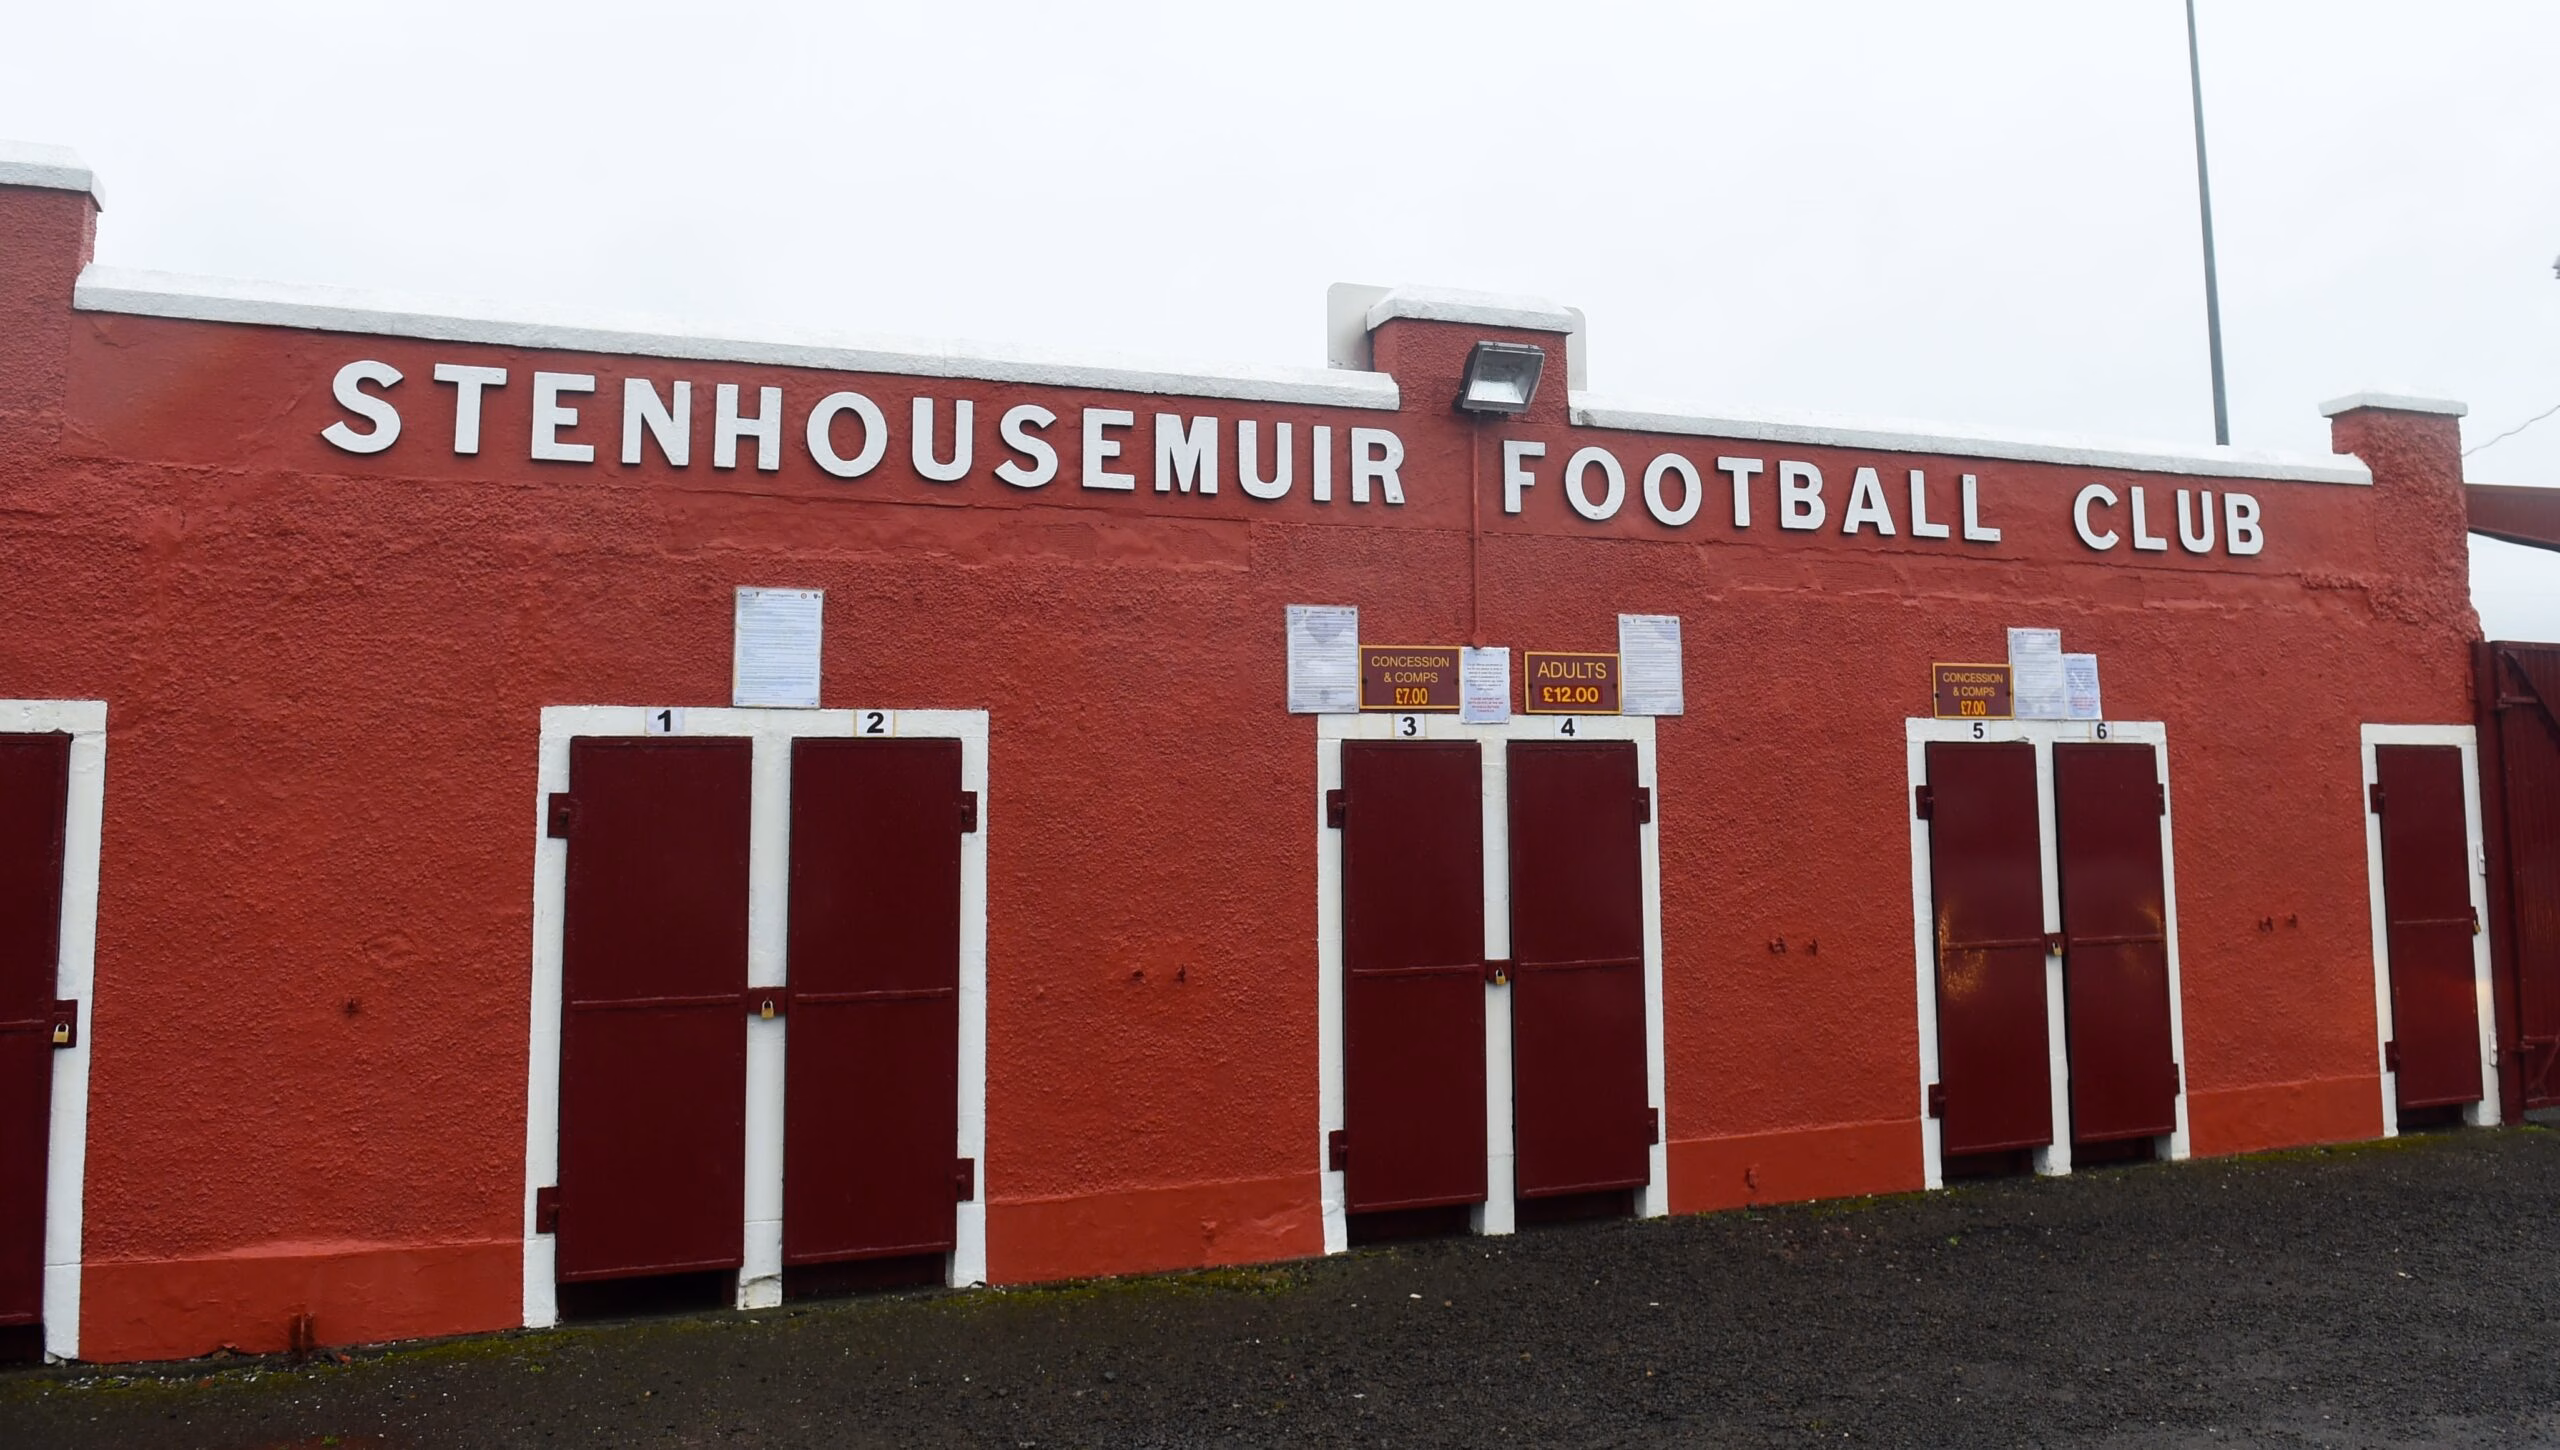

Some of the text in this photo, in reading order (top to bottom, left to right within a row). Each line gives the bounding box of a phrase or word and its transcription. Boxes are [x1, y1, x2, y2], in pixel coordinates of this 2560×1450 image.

[321, 360, 2264, 555] STENHOUSEMUIR FOOTBALL CLUB
[1371, 656, 1450, 667] CONCESSION
[1537, 661, 1607, 679] ADULTS
[1384, 671, 1439, 683] & COMPS
[1943, 672, 2004, 684] CONCESSION
[1396, 688, 1428, 705] £7.00
[1543, 687, 1599, 703] £12.00
[1953, 686, 1996, 698] & COMPS
[1961, 701, 1986, 716] £7.00
[657, 710, 671, 732] 1
[867, 712, 885, 734] 2
[1402, 717, 1417, 737] 3
[1561, 718, 1575, 737] 4
[1973, 722, 1984, 739] 5
[2096, 723, 2107, 739] 6
